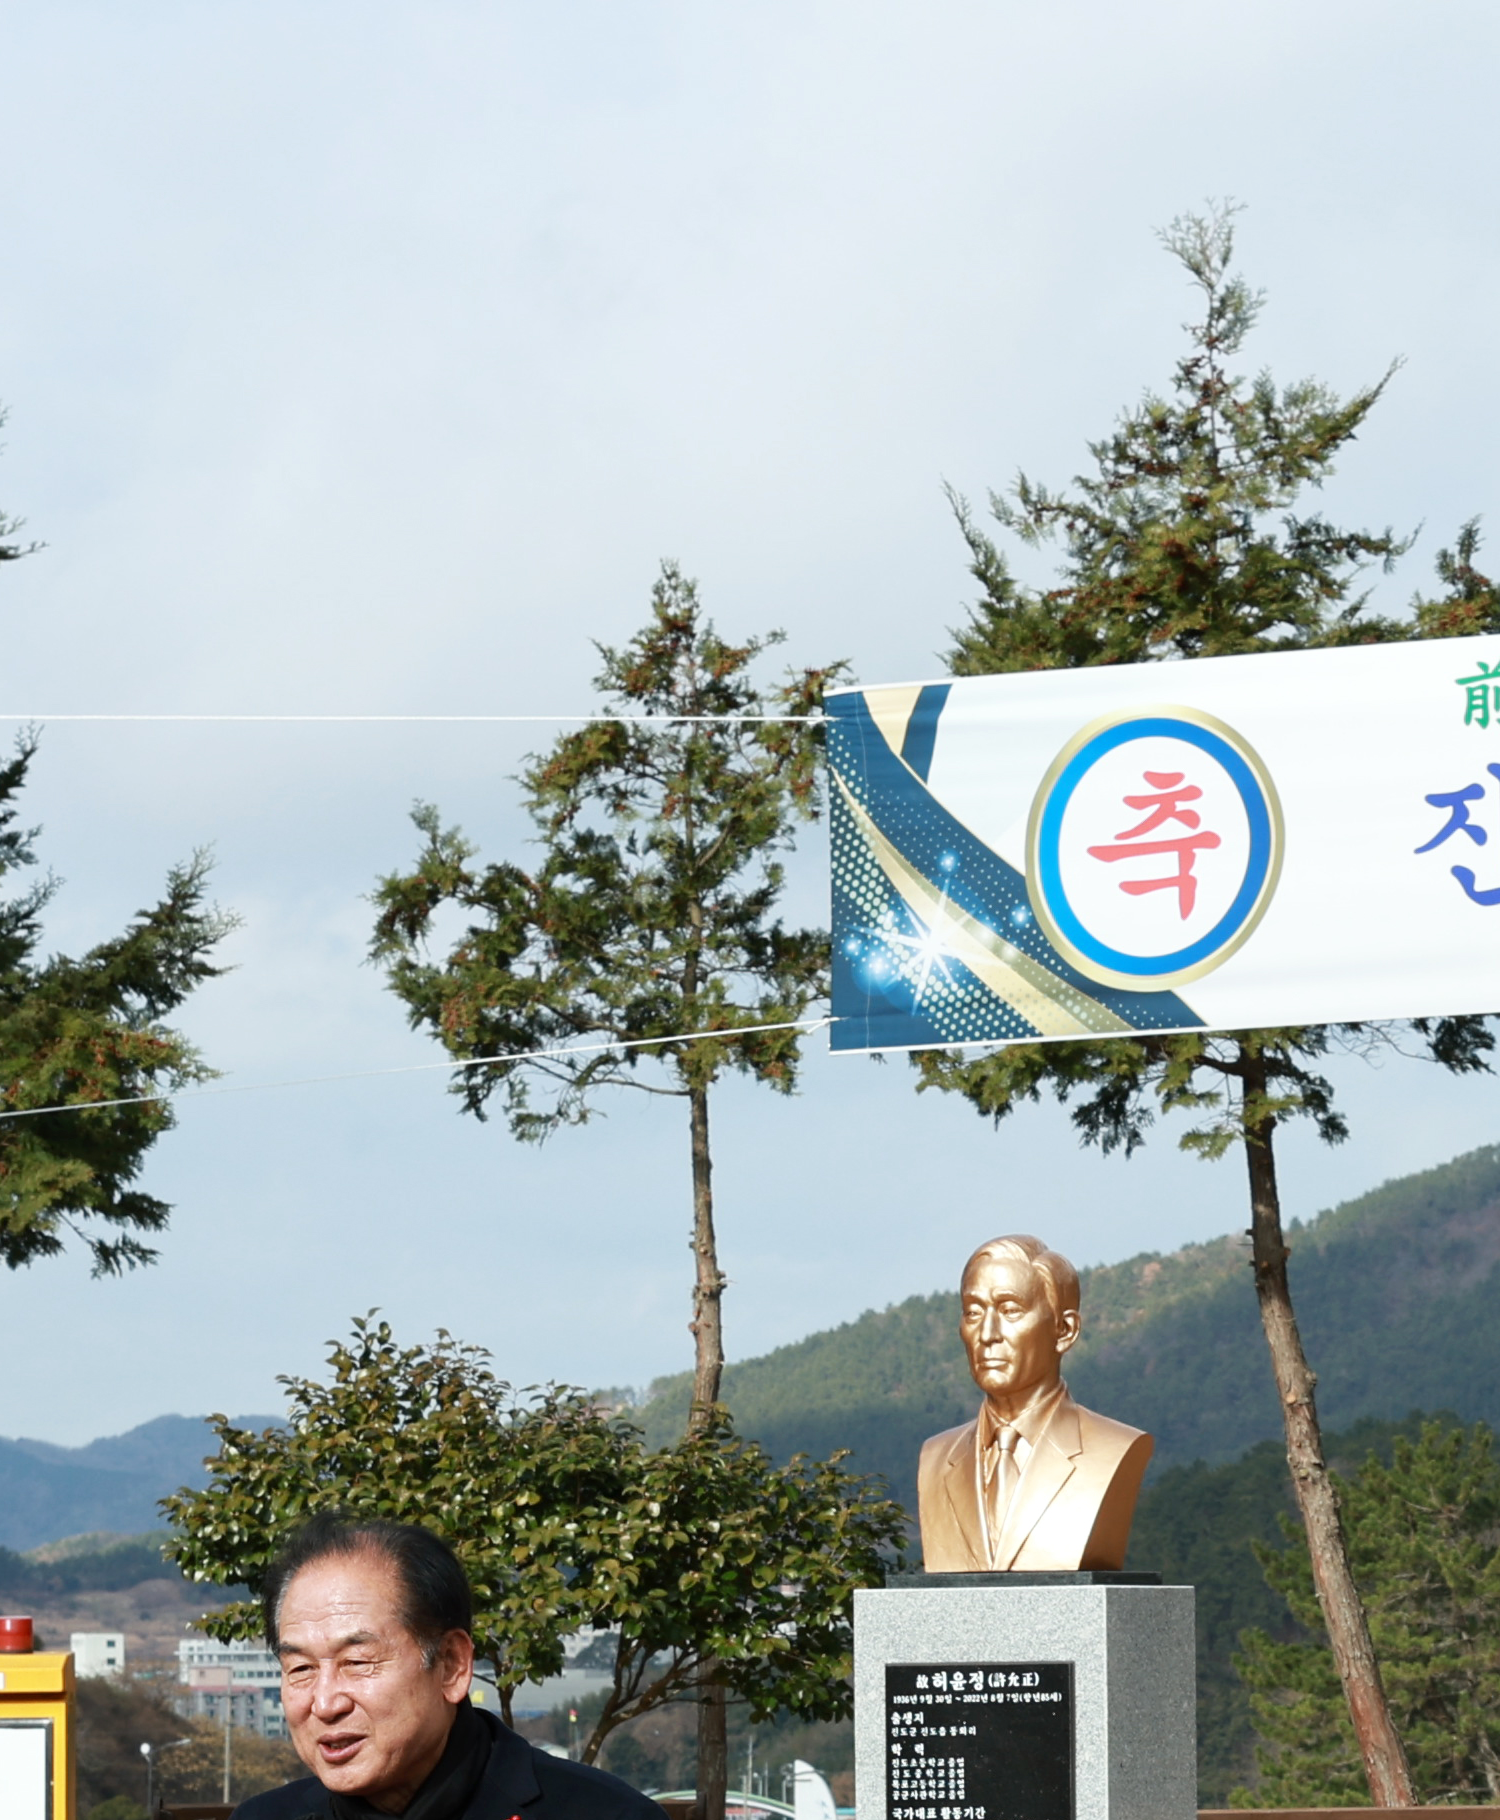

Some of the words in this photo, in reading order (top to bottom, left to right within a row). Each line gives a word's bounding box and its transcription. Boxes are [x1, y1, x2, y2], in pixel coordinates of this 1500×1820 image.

[1083, 766, 1226, 925] 축
[891, 1712, 924, 1725] 출생지
[892, 1727, 917, 1737] 진도군
[892, 1807, 937, 1820] 국가대표
[940, 1806, 986, 1820] 활동기간
